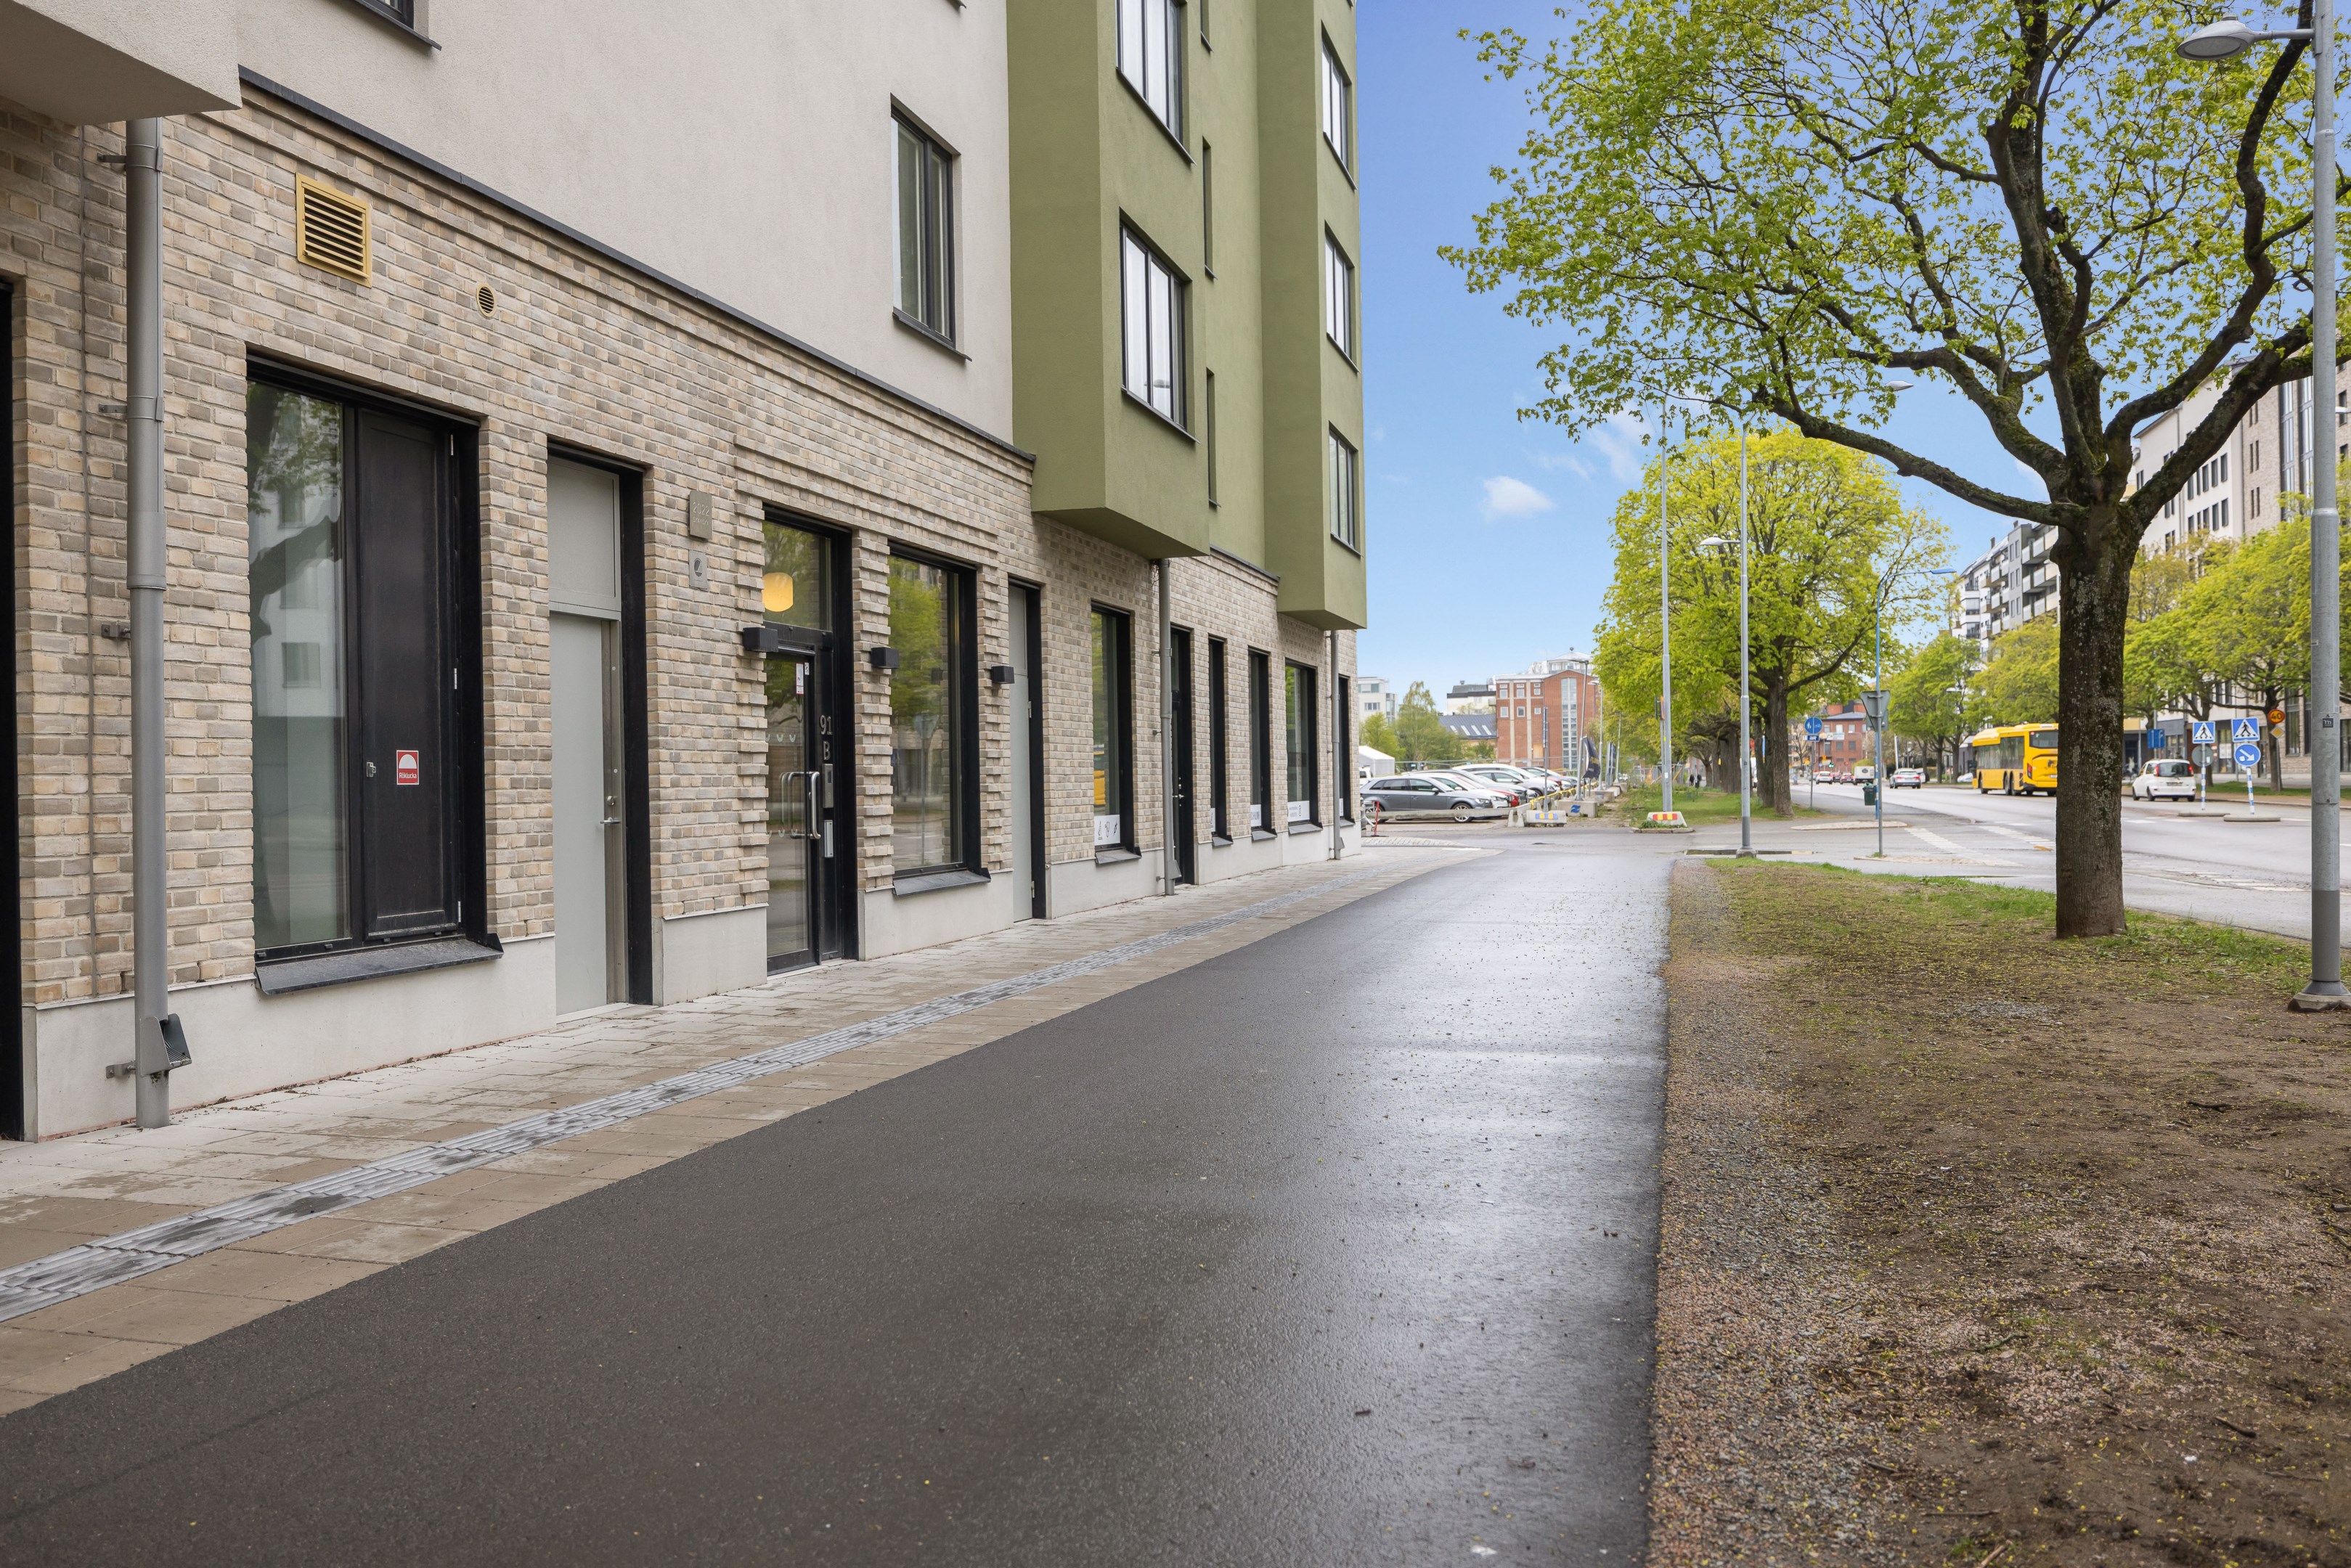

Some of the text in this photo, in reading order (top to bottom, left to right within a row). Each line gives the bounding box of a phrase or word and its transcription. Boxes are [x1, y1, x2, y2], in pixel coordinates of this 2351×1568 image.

[693, 502, 709, 517] 2022
[820, 714, 833, 735] 91
[823, 740, 831, 760] B
